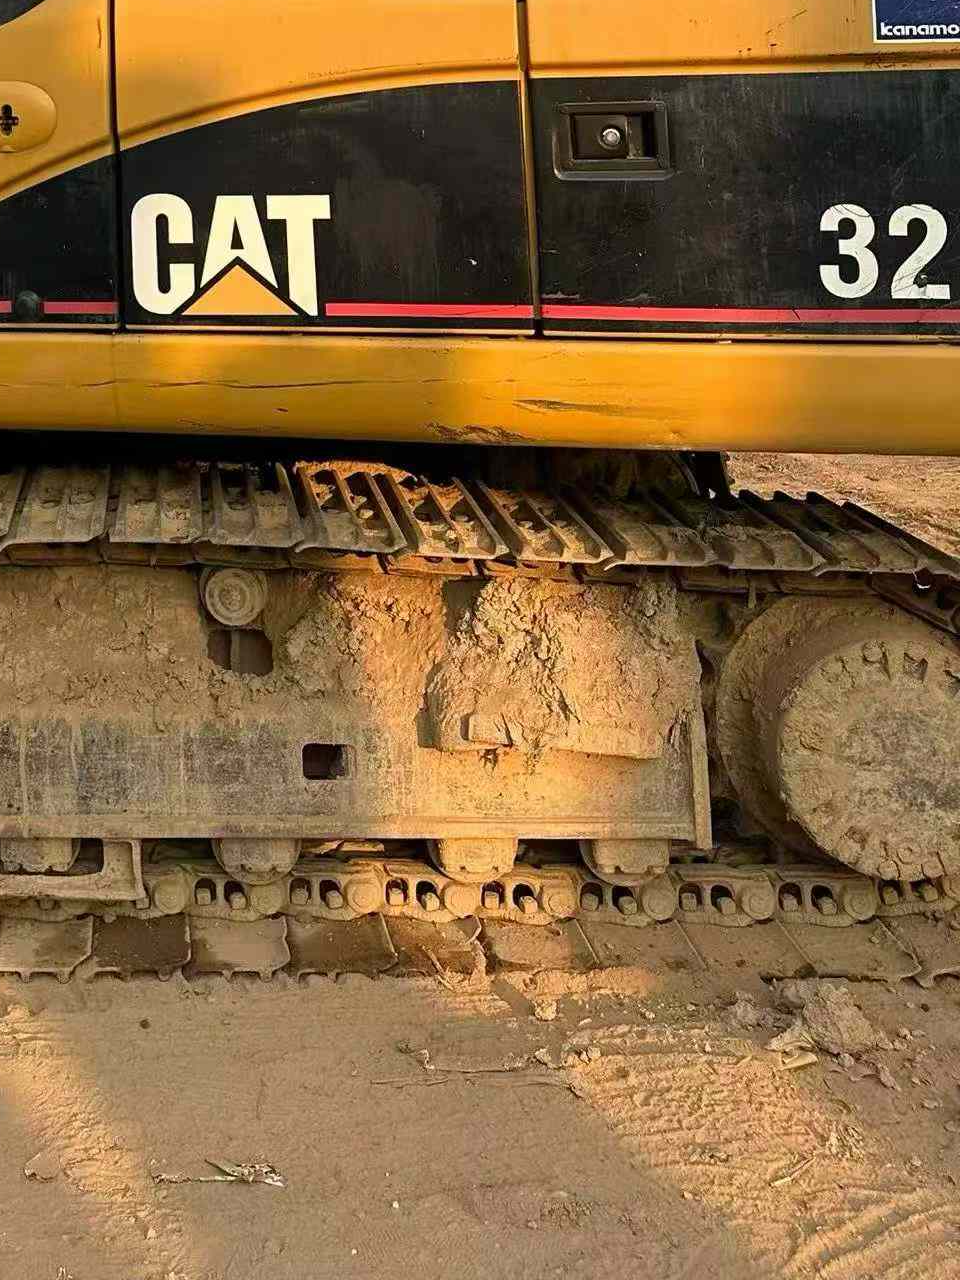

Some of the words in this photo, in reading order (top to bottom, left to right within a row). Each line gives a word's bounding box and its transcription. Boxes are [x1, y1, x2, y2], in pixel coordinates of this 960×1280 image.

[880, 22, 960, 36] kanamo
[131, 193, 331, 317] CAT
[820, 204, 951, 300] 32
